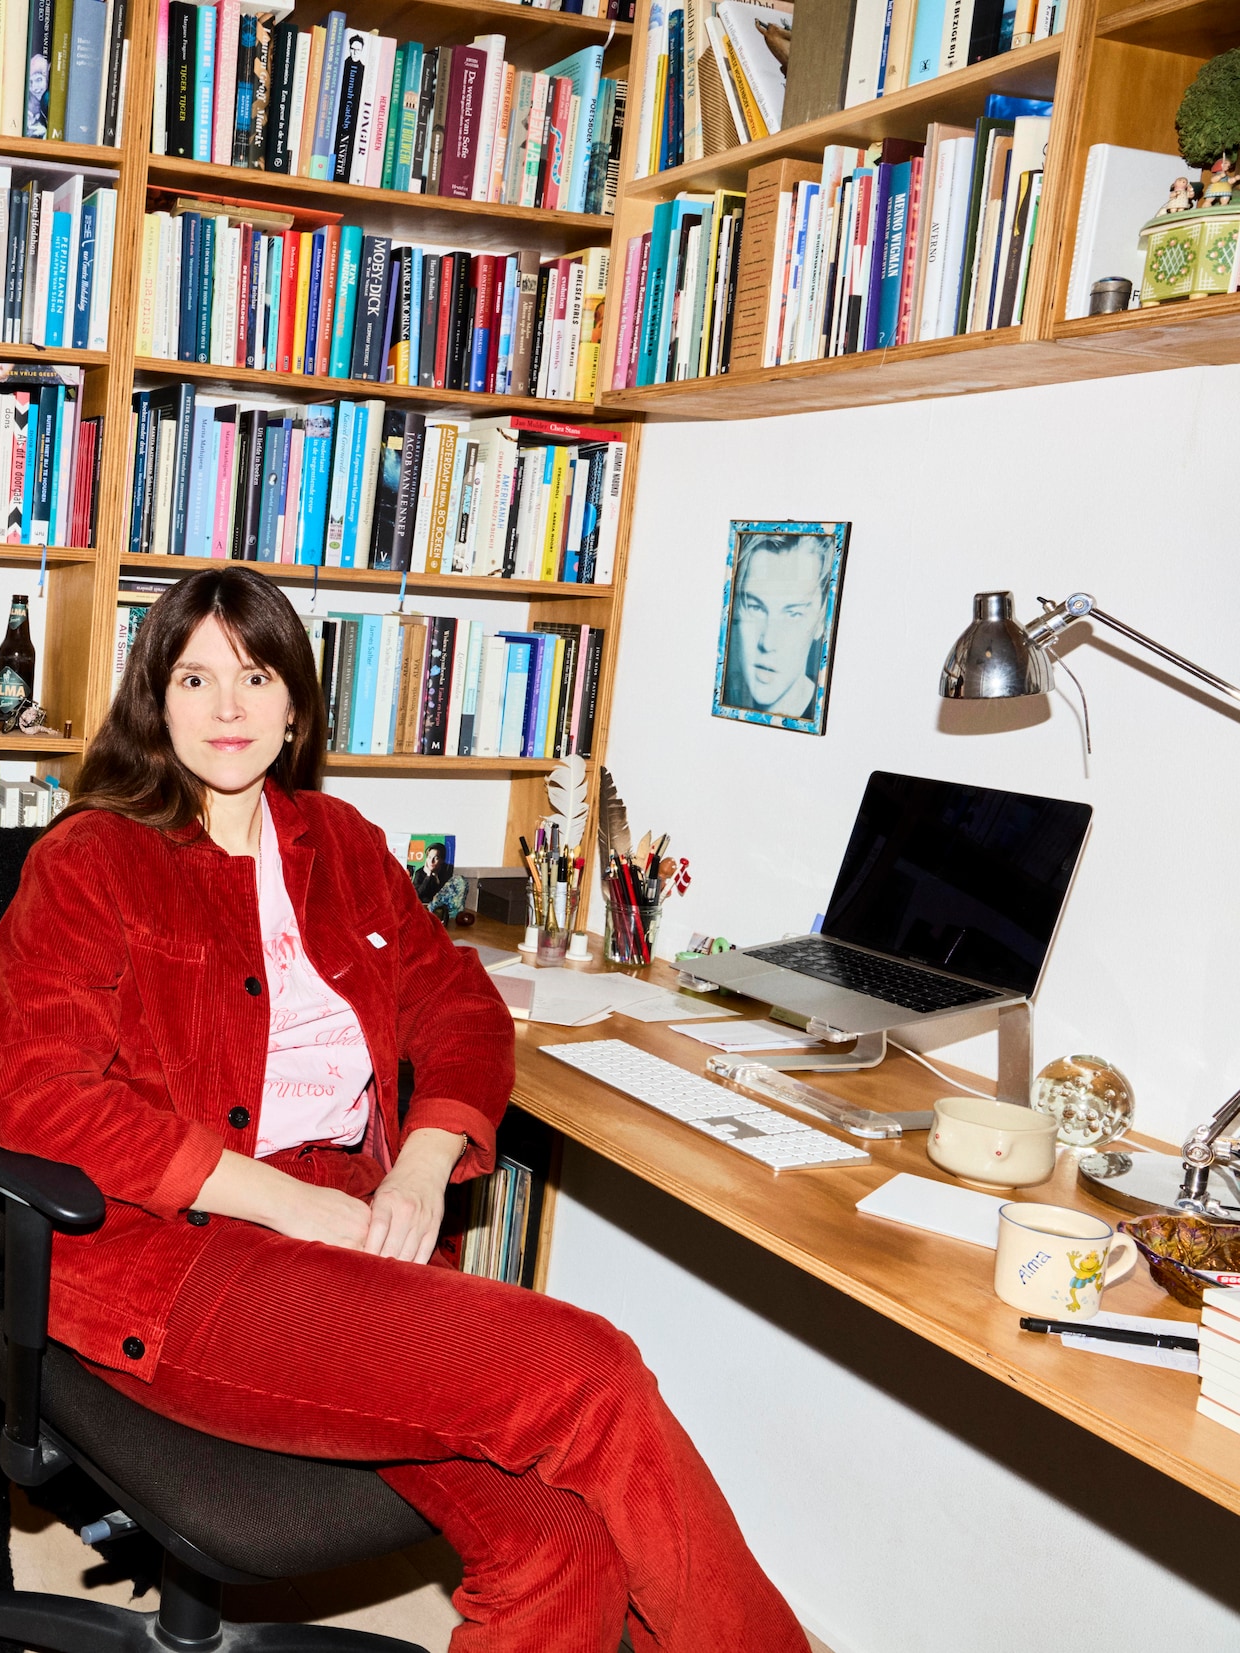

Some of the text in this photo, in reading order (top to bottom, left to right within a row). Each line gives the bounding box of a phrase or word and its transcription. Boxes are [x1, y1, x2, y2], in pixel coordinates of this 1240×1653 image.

[342, 65, 358, 131] Hannah Gadsby
[468, 71, 476, 83] De
[179, 94, 187, 121] TIJGER
[374, 96, 387, 151] HEMELLICHAMEN
[464, 86, 473, 117] wereld
[586, 98, 596, 143] POETSBOEK
[336, 134, 350, 175] NANETTE
[462, 136, 470, 158] Sofie
[888, 193, 906, 277] MENNO WIGMAN
[928, 222, 940, 263] AVERNO
[55, 236, 69, 314] PEPIJN LANEN
[367, 239, 386, 317] MOBY-DICK
[572, 269, 584, 325] CHELSEA GIRLS
[142, 277, 156, 334] magnus
[4, 408, 13, 429] dons
[549, 424, 581, 435] Chez Stans
[11, 434, 26, 505] Als dit zo doorgaat
[441, 429, 455, 482] AMSTERDAM
[397, 432, 415, 537] JACOB VAN LENNEP
[496, 474, 511, 529] AMERIKANAH
[437, 510, 446, 525] 80
[433, 526, 445, 559] BOEKEN
[116, 624, 127, 673] Ali Smith
[264, 1078, 335, 1097] rincess
[1018, 1249, 1052, 1285] Alma
